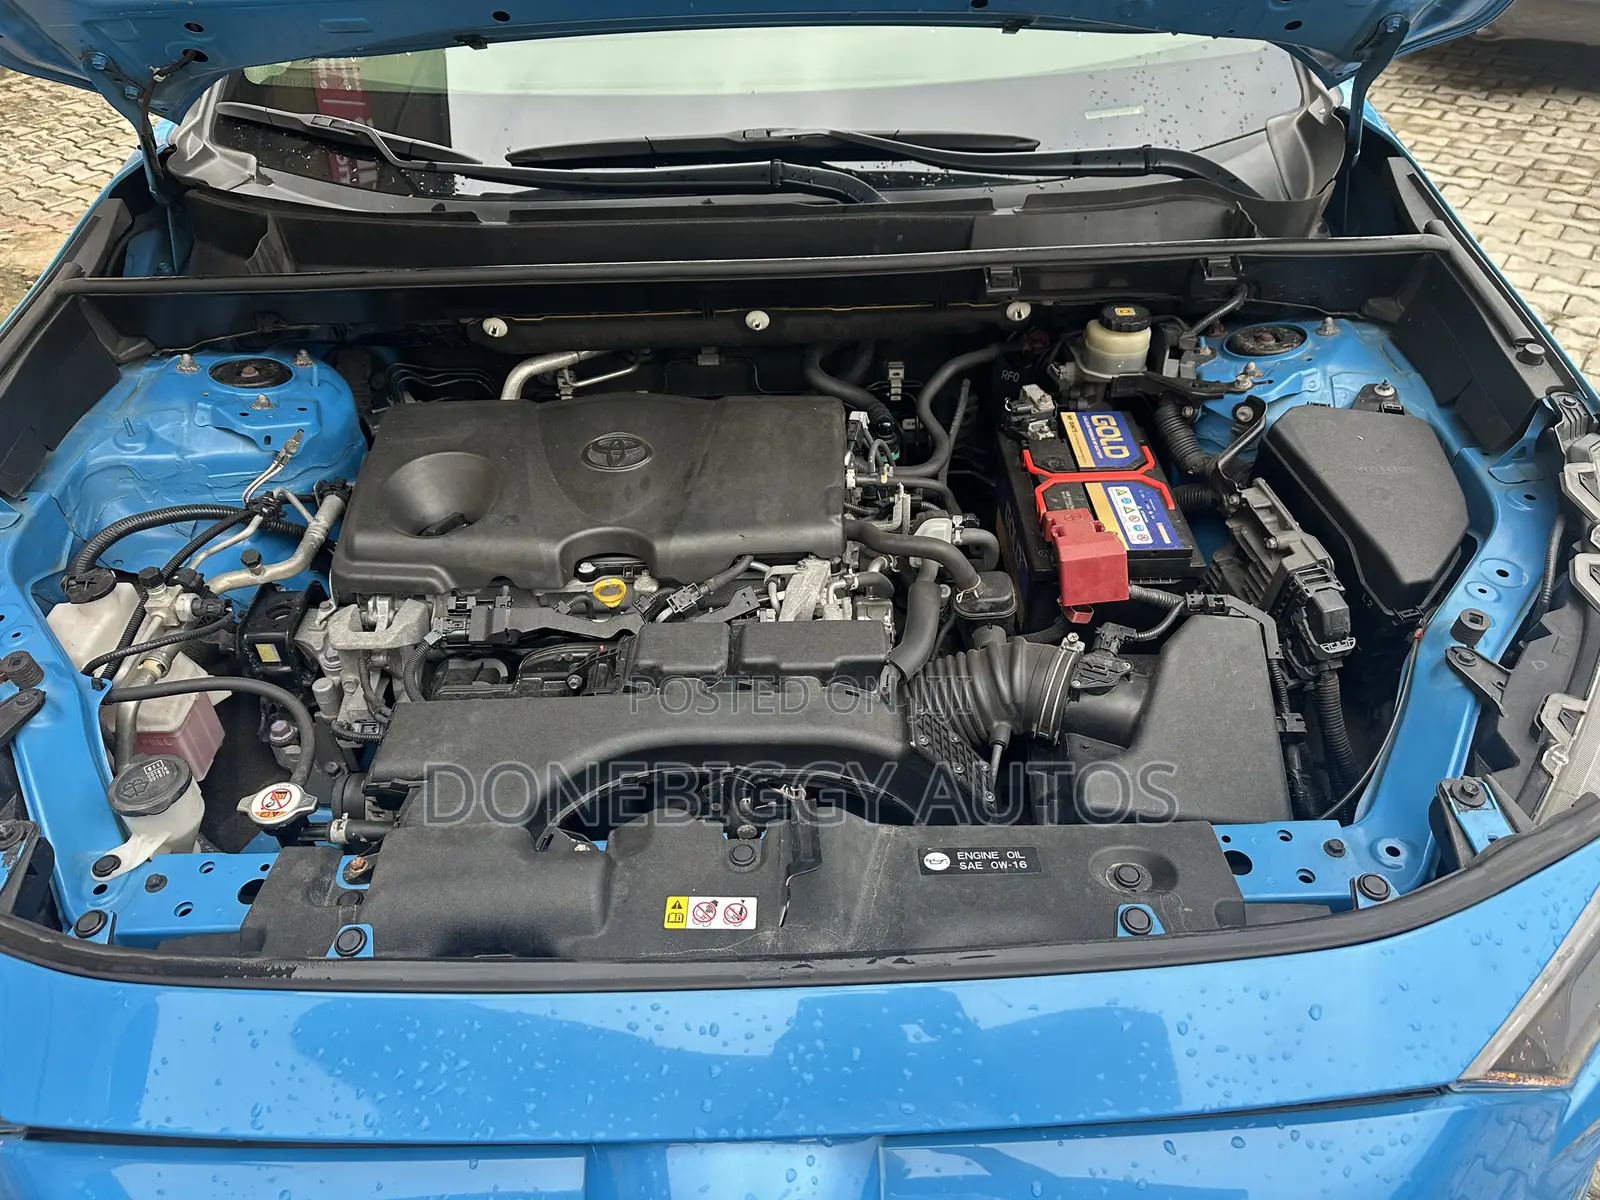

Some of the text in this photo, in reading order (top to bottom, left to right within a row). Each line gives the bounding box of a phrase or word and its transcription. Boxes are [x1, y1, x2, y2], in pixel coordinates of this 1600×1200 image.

[1090, 414, 1131, 459] GOLD
[957, 851, 1025, 860] ENGINE OIL
[959, 860, 1028, 870] SAE 0W-16
